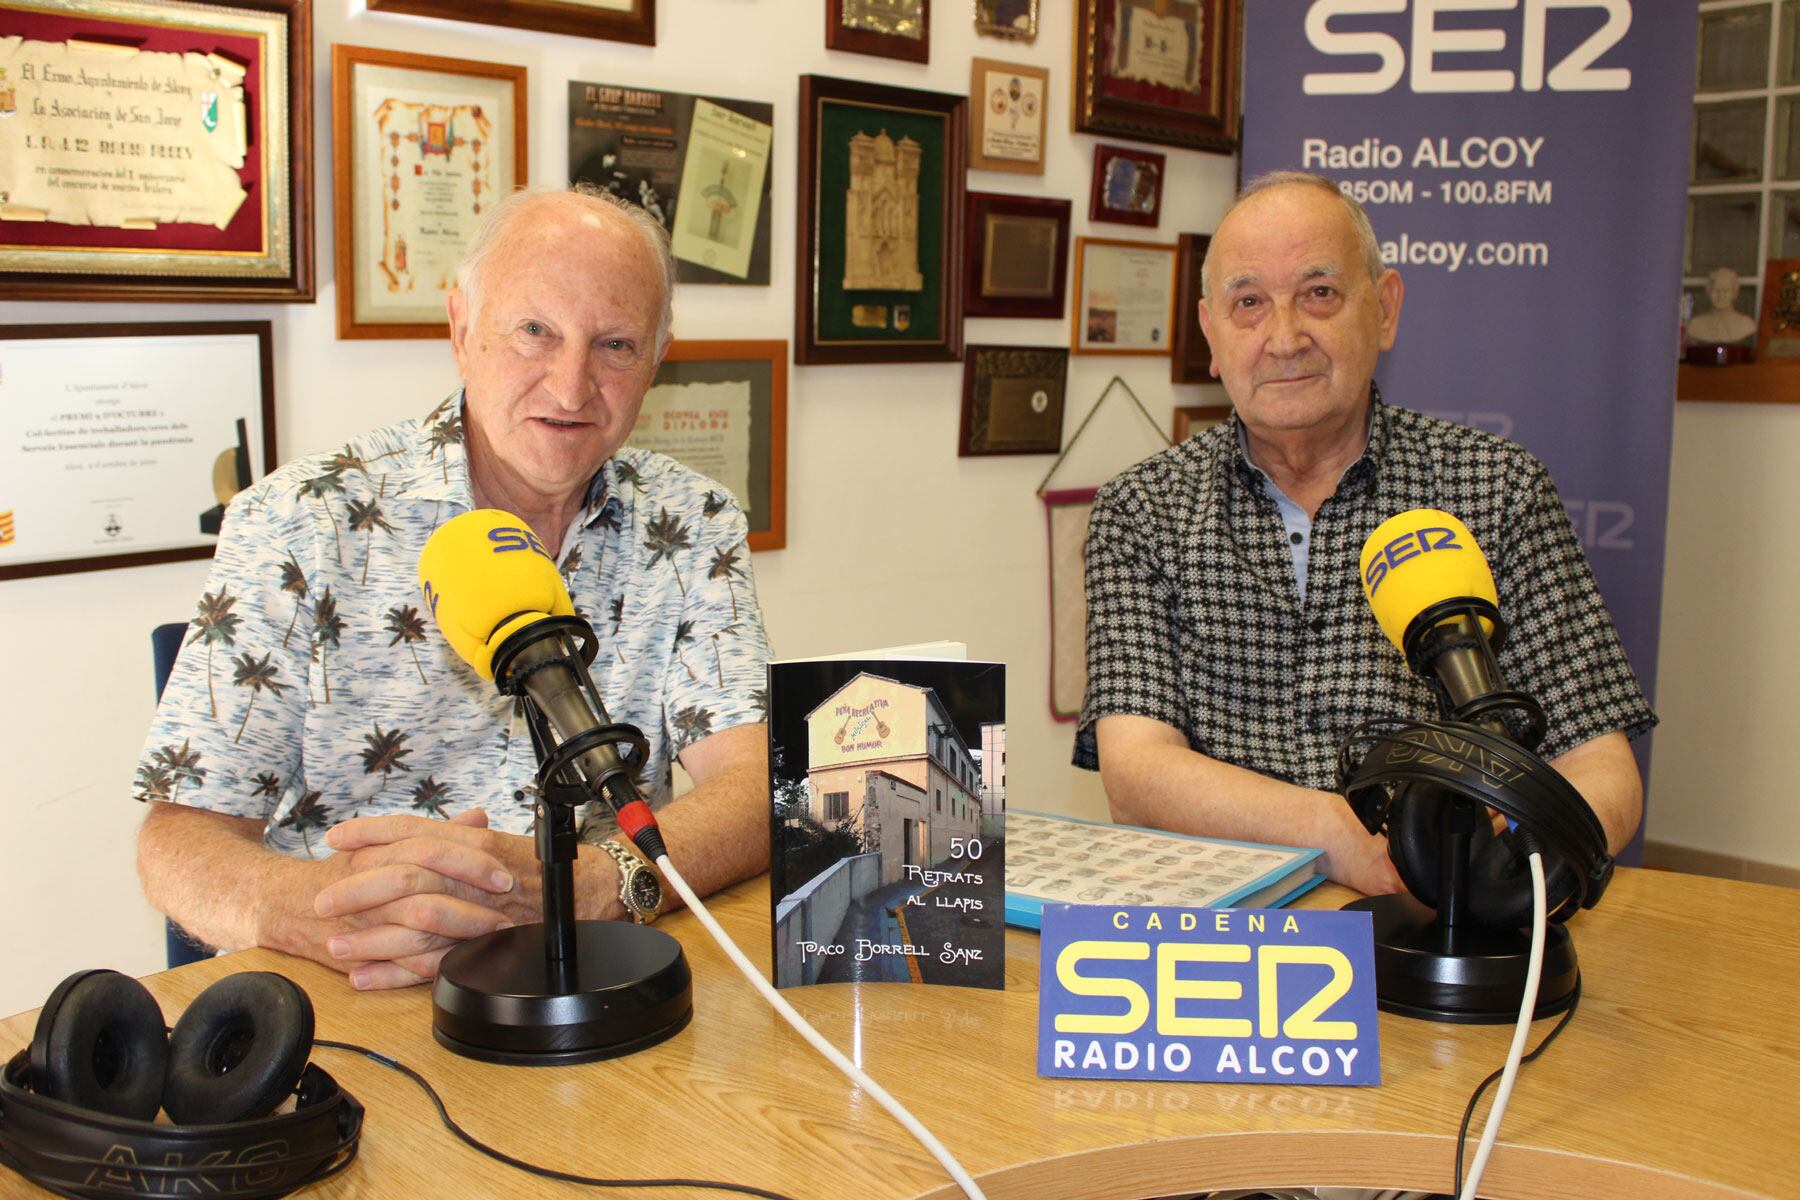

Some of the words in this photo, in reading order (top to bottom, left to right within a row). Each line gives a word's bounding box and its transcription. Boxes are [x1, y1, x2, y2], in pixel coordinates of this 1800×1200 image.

[1302, 0, 1632, 95] SER
[1303, 138, 1402, 169] Radio
[1411, 136, 1545, 169] ALCOY
[1440, 180, 1552, 205] 100.8FM
[1365, 527, 1463, 598] SER
[950, 837, 983, 860] 50
[902, 864, 983, 888] RETRATS
[907, 895, 926, 906] AL
[936, 896, 983, 913] LLAPIS
[1112, 911, 1300, 934] CADENA
[796, 941, 845, 963] PACO
[855, 939, 930, 961] BORRELL
[939, 942, 984, 966] SANZ
[1054, 940, 1358, 1040] SER
[1054, 1039, 1192, 1073] RADIO
[1216, 1044, 1359, 1077] ALCOY
[85, 1139, 290, 1194] AKG
